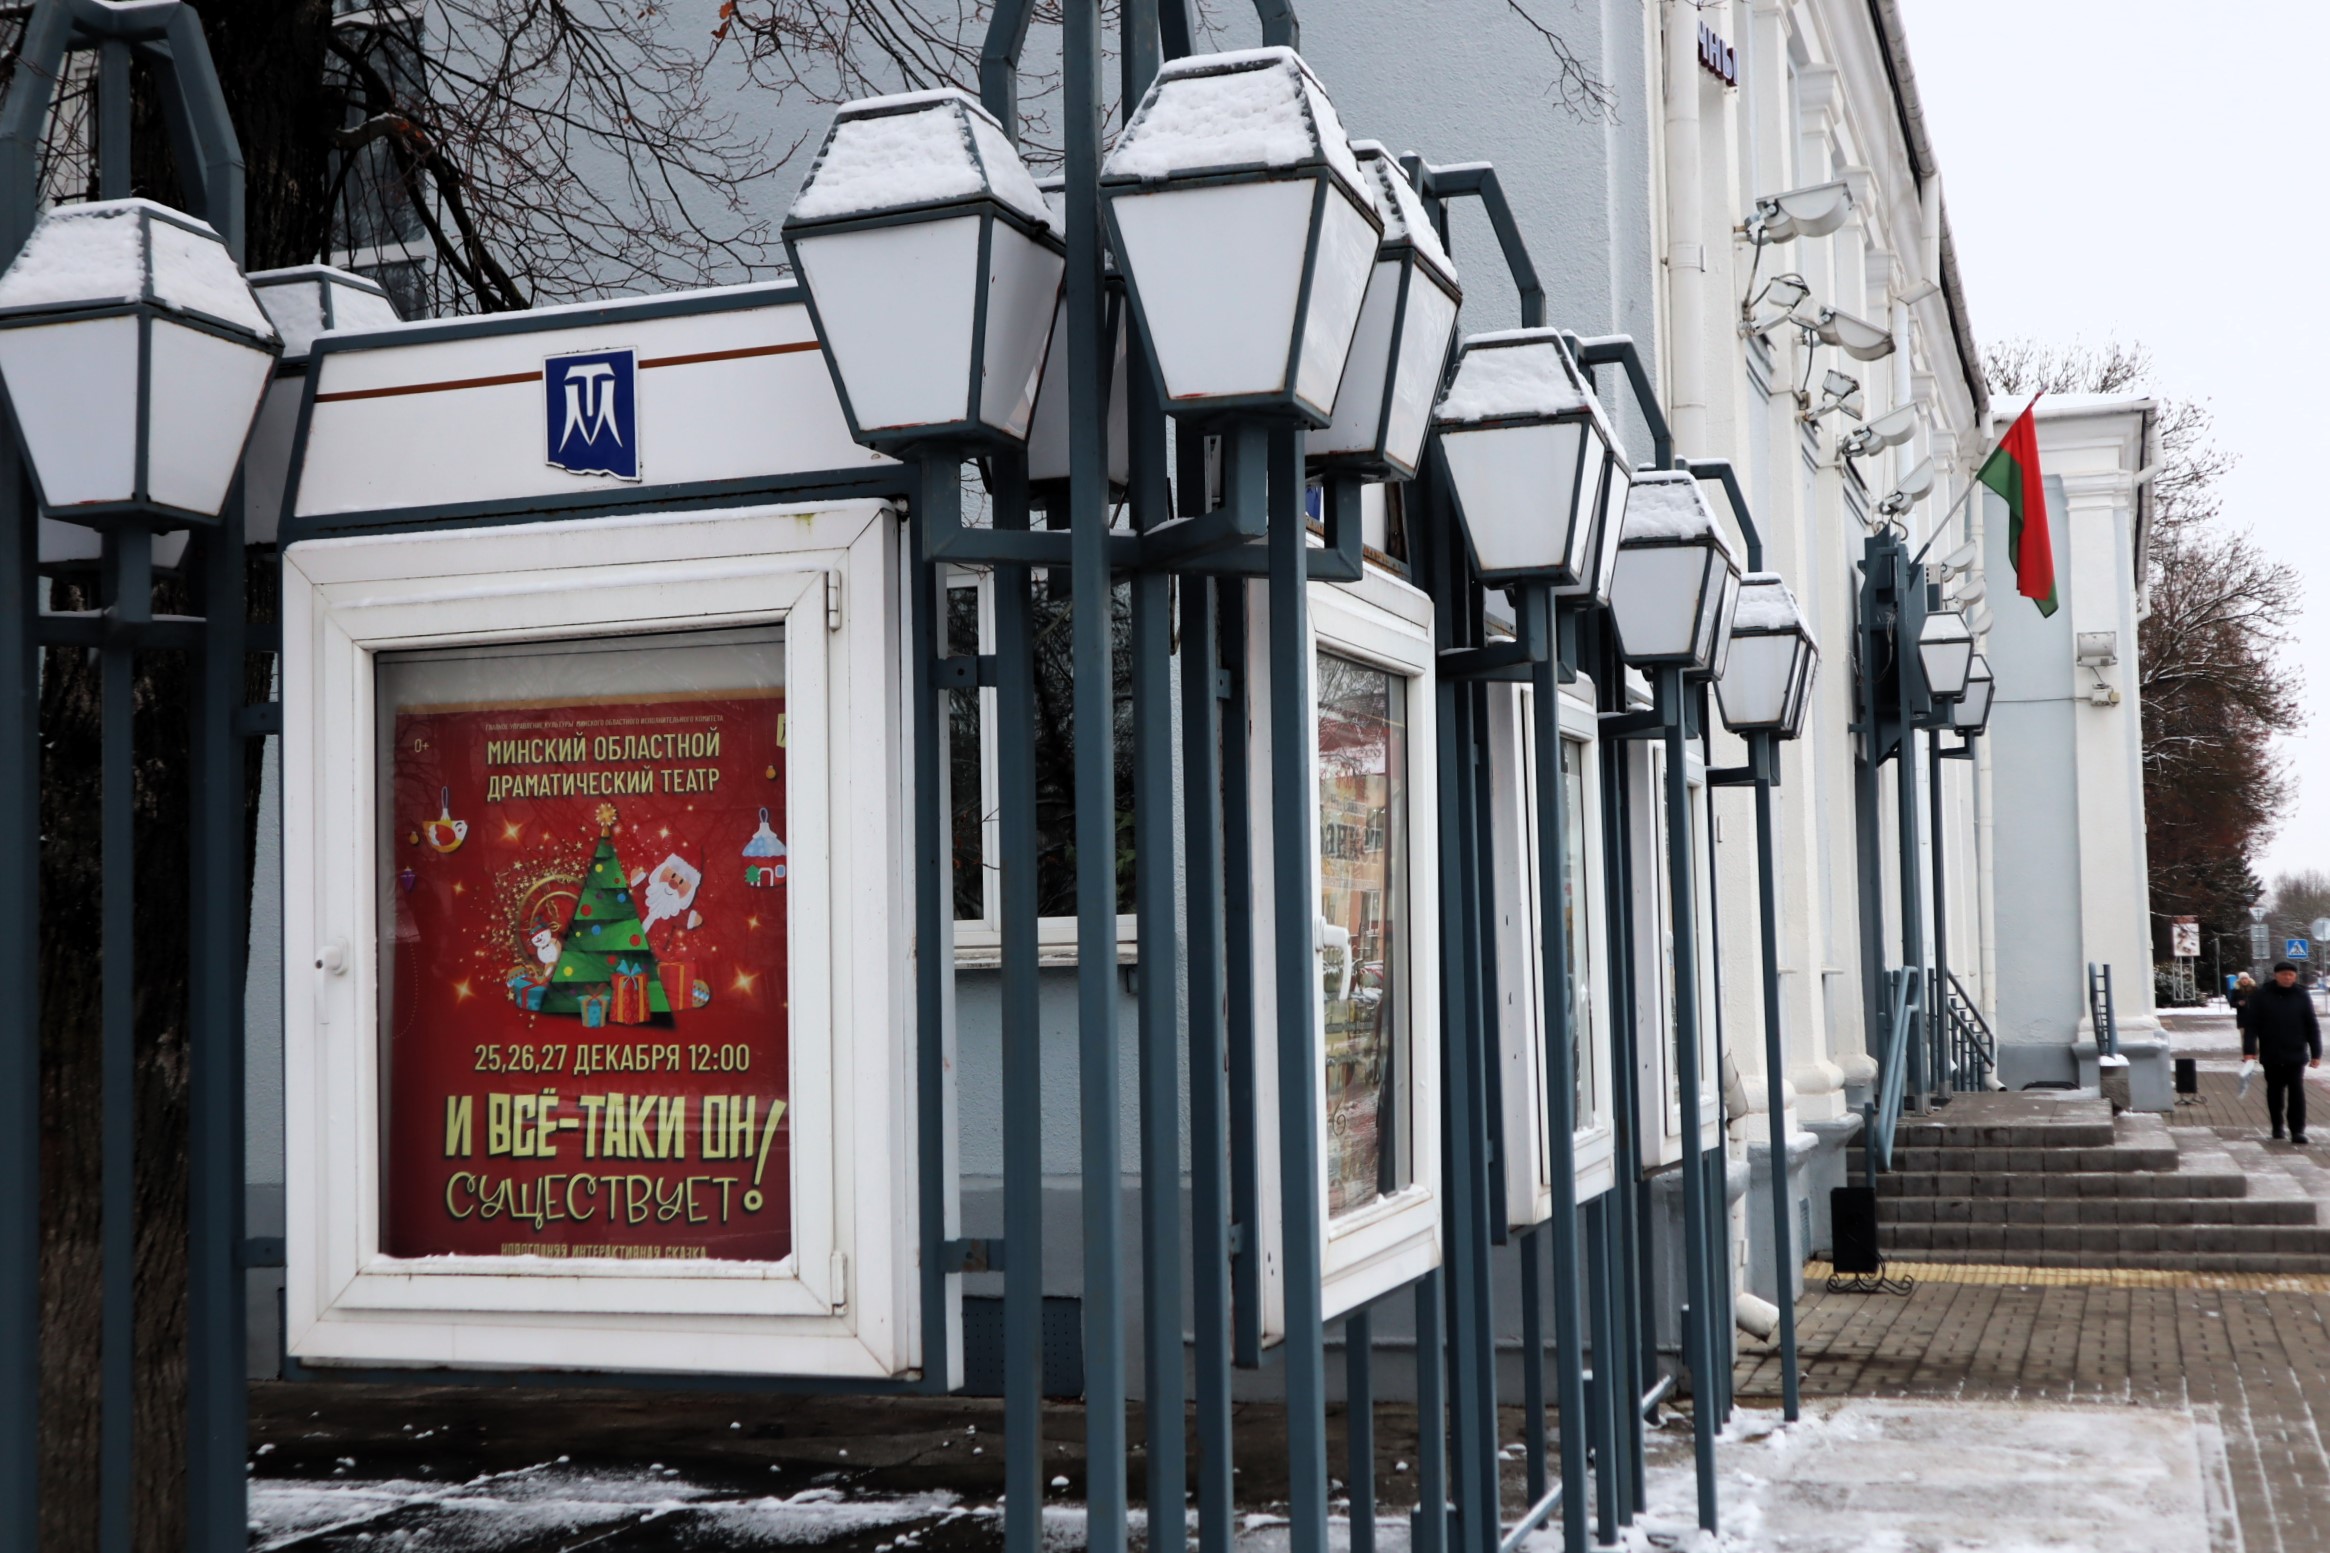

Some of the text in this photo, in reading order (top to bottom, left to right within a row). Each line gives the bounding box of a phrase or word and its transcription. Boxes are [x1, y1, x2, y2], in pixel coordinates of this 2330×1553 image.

[544, 719, 573, 728] КУЛЬТУРЫ
[576, 718, 604, 727] МИНСКОГО
[605, 717, 639, 726] ОБЛАСТНОГО
[640, 715, 693, 724] ИСПОЛНИТЕЛЬНОГО
[695, 714, 724, 723] КОМИТЕТА
[414, 738, 430, 753] 0+
[487, 727, 720, 765] МИНСКИЙ ОБЛАСТНОЙ
[487, 766, 720, 802] ДРАМАТИЧЕСКИЙ ТЕАТР
[474, 1044, 750, 1075] 25,26,27 ДЕКАБРЯ 12:00
[445, 1095, 472, 1156] И
[488, 1087, 686, 1159] ВСЁ-ТАКИ
[572, 1245, 660, 1259] ИНТЕРАКТИВНАЯ
[665, 1246, 707, 1259] СКАЗКА
